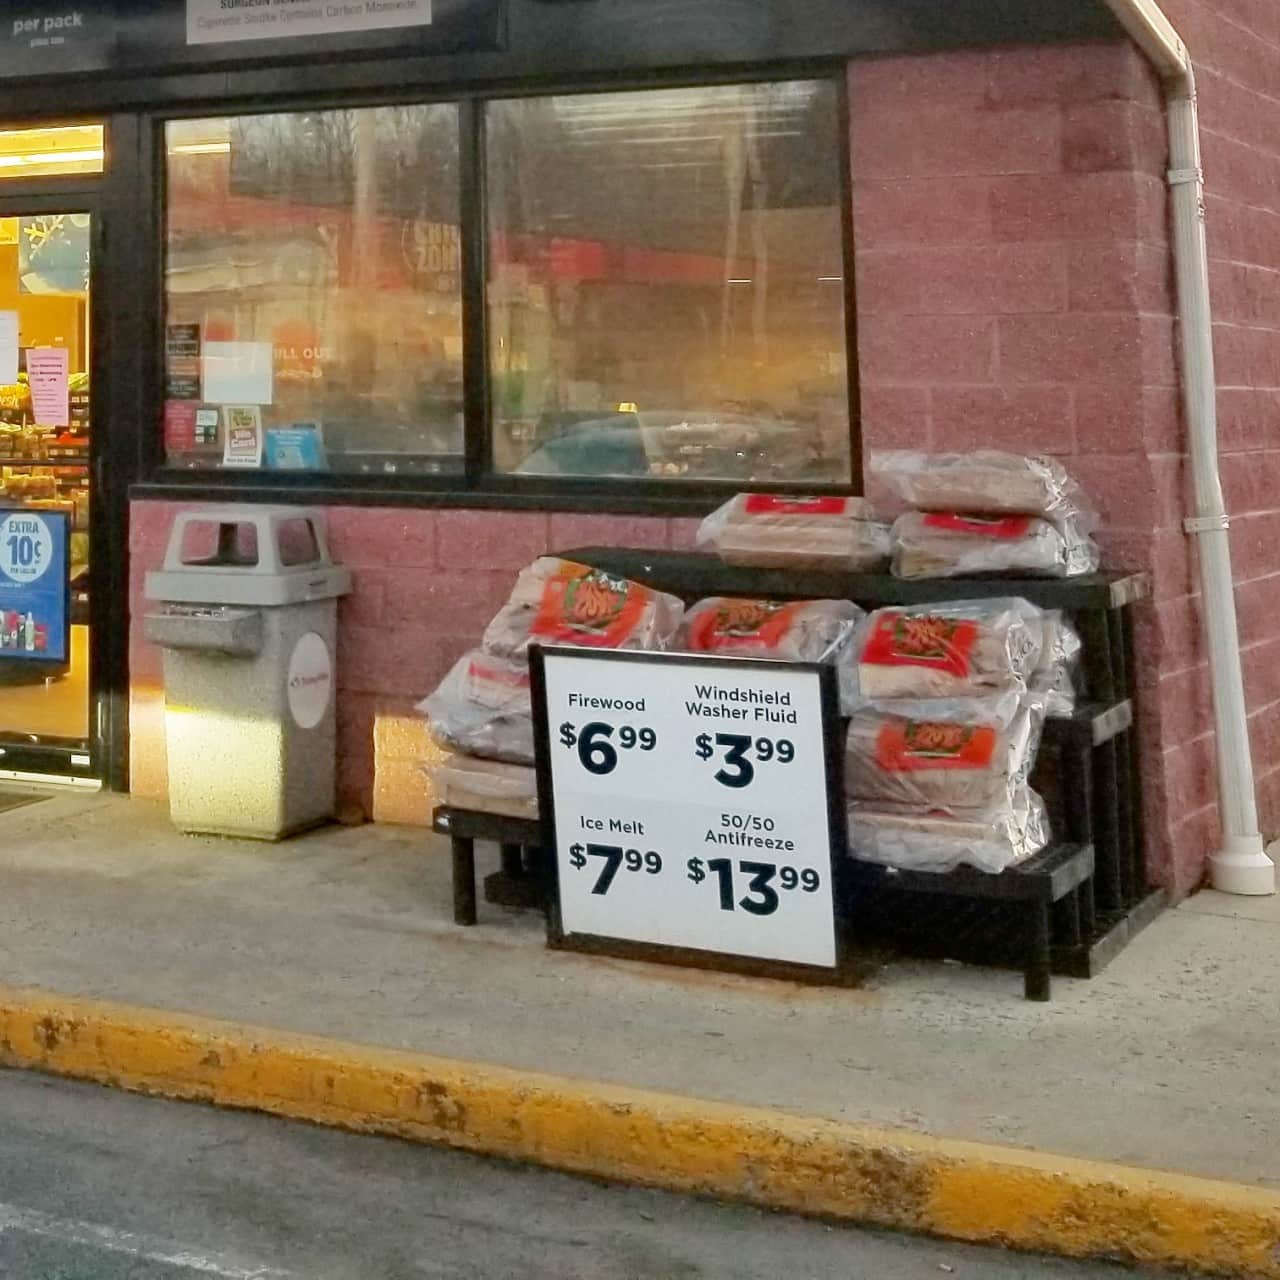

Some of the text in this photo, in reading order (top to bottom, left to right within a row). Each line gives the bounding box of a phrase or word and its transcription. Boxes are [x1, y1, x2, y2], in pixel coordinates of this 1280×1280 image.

[13, 11, 83, 35] per pack
[8, 520, 39, 534] EXTRA
[567, 693, 646, 712] Firewood
[694, 684, 791, 707] Windshield
[685, 701, 797, 725] Washer Fluid
[580, 815, 645, 835] Ice Melt
[720, 812, 775, 832] 50/50
[704, 829, 795, 852] Antifreeze
